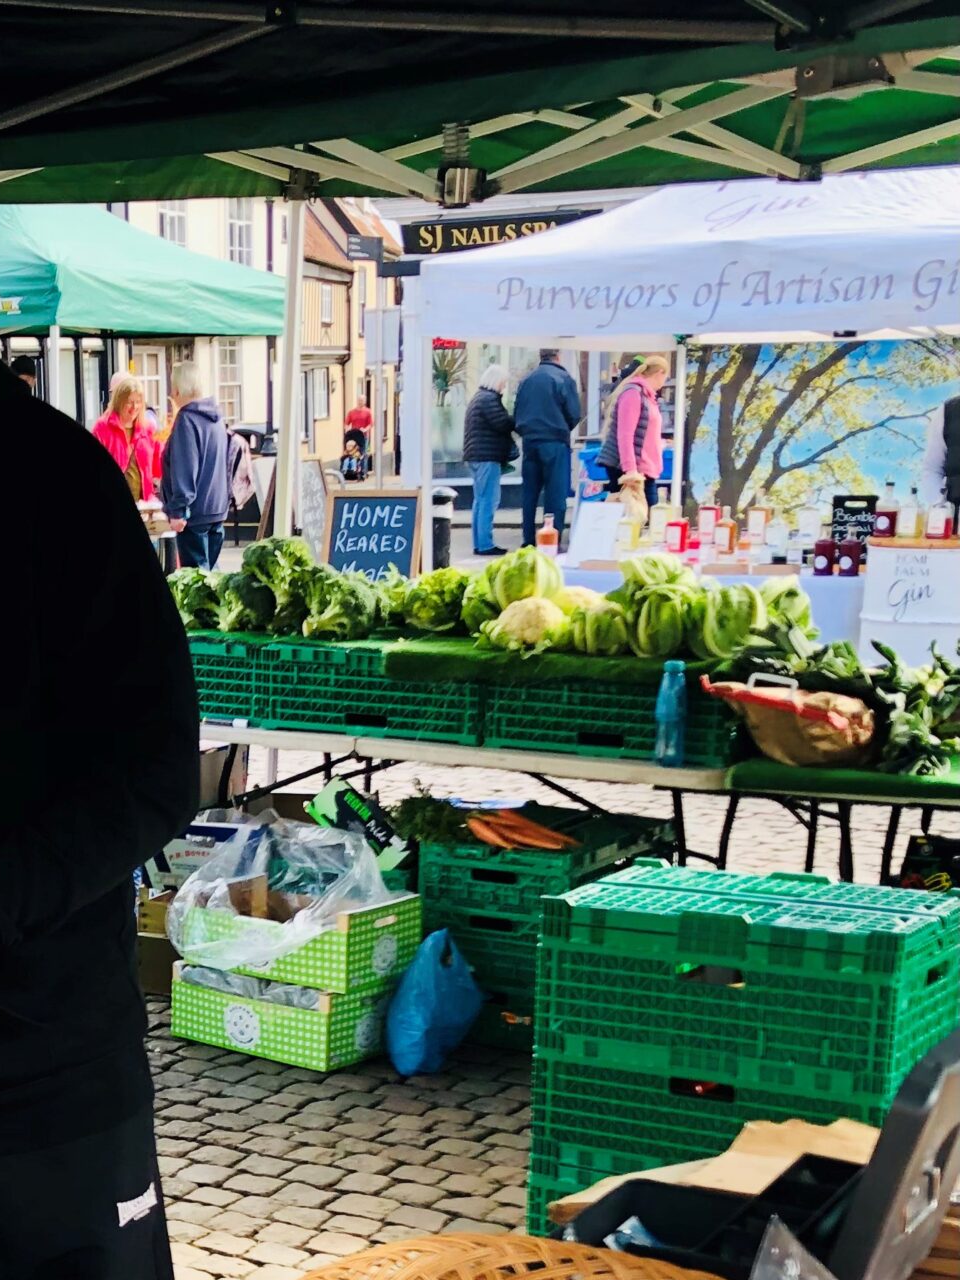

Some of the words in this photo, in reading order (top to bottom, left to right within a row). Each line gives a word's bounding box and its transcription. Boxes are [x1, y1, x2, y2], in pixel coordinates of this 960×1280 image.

[705, 194, 817, 232] Gin
[419, 225, 443, 253] SJ
[451, 223, 517, 247] NAILS
[497, 276, 679, 329] Purveyors
[692, 260, 739, 327] of
[742, 266, 894, 308] Artisan
[340, 503, 408, 529] HOME
[334, 529, 407, 554] REARED
[888, 579, 933, 621] Gin
